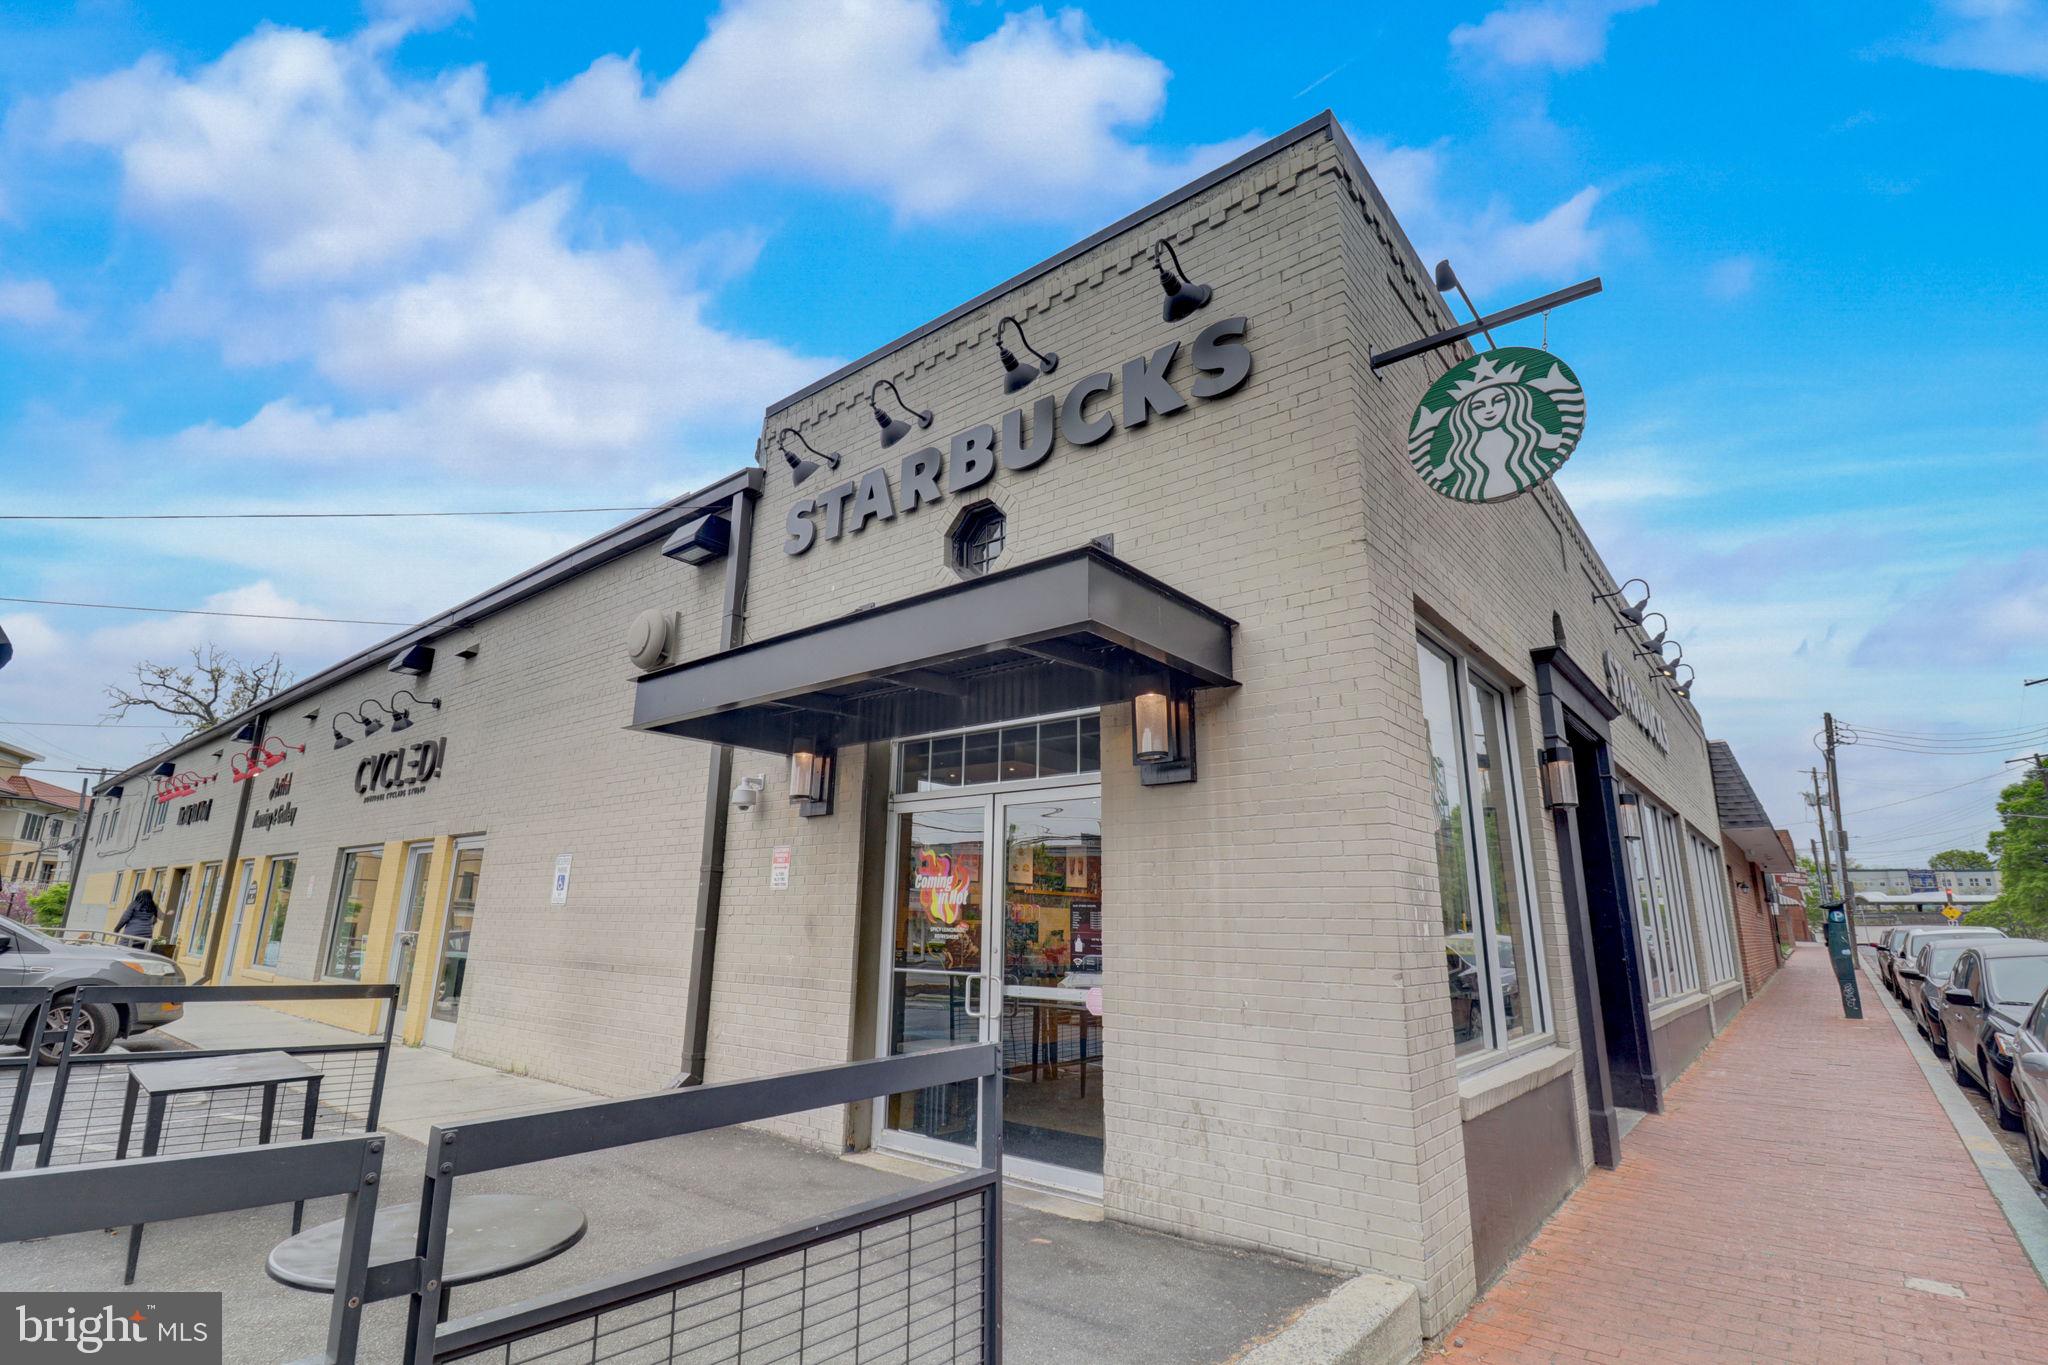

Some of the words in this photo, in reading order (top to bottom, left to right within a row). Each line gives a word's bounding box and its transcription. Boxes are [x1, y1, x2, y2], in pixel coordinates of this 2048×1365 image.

[783, 316, 1252, 556] STARBUCKS
[355, 736, 447, 794] CYCLED!
[915, 873, 953, 891] Coming
